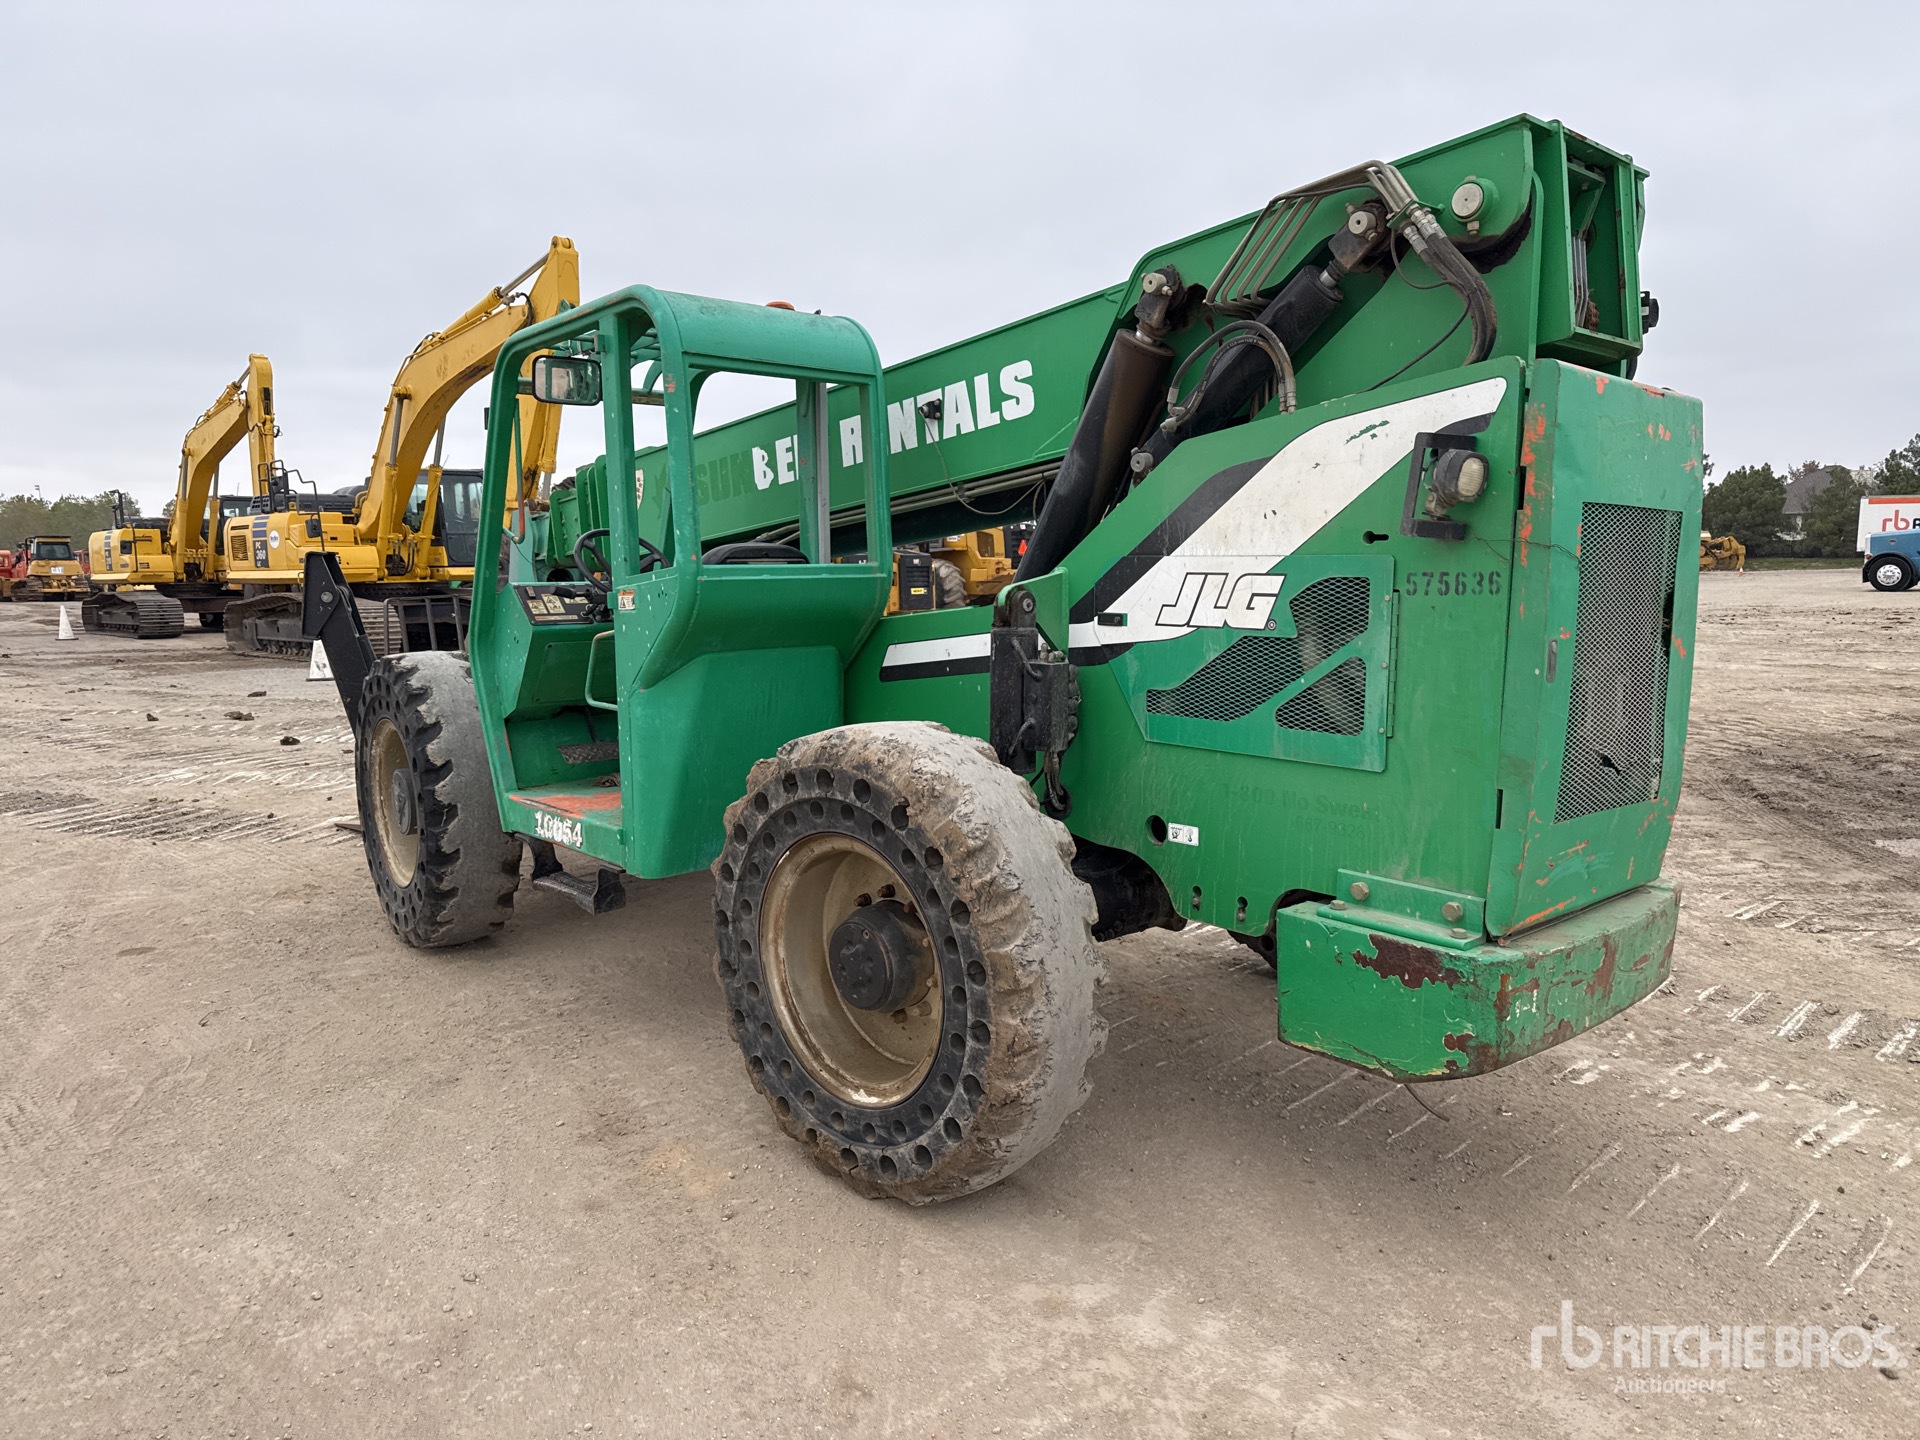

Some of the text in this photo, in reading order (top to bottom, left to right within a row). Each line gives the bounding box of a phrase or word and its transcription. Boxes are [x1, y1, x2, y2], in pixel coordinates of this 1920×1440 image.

[839, 359, 1035, 468] RNTALS
[1882, 510, 1910, 532] rb
[1406, 570, 1502, 596] 575636
